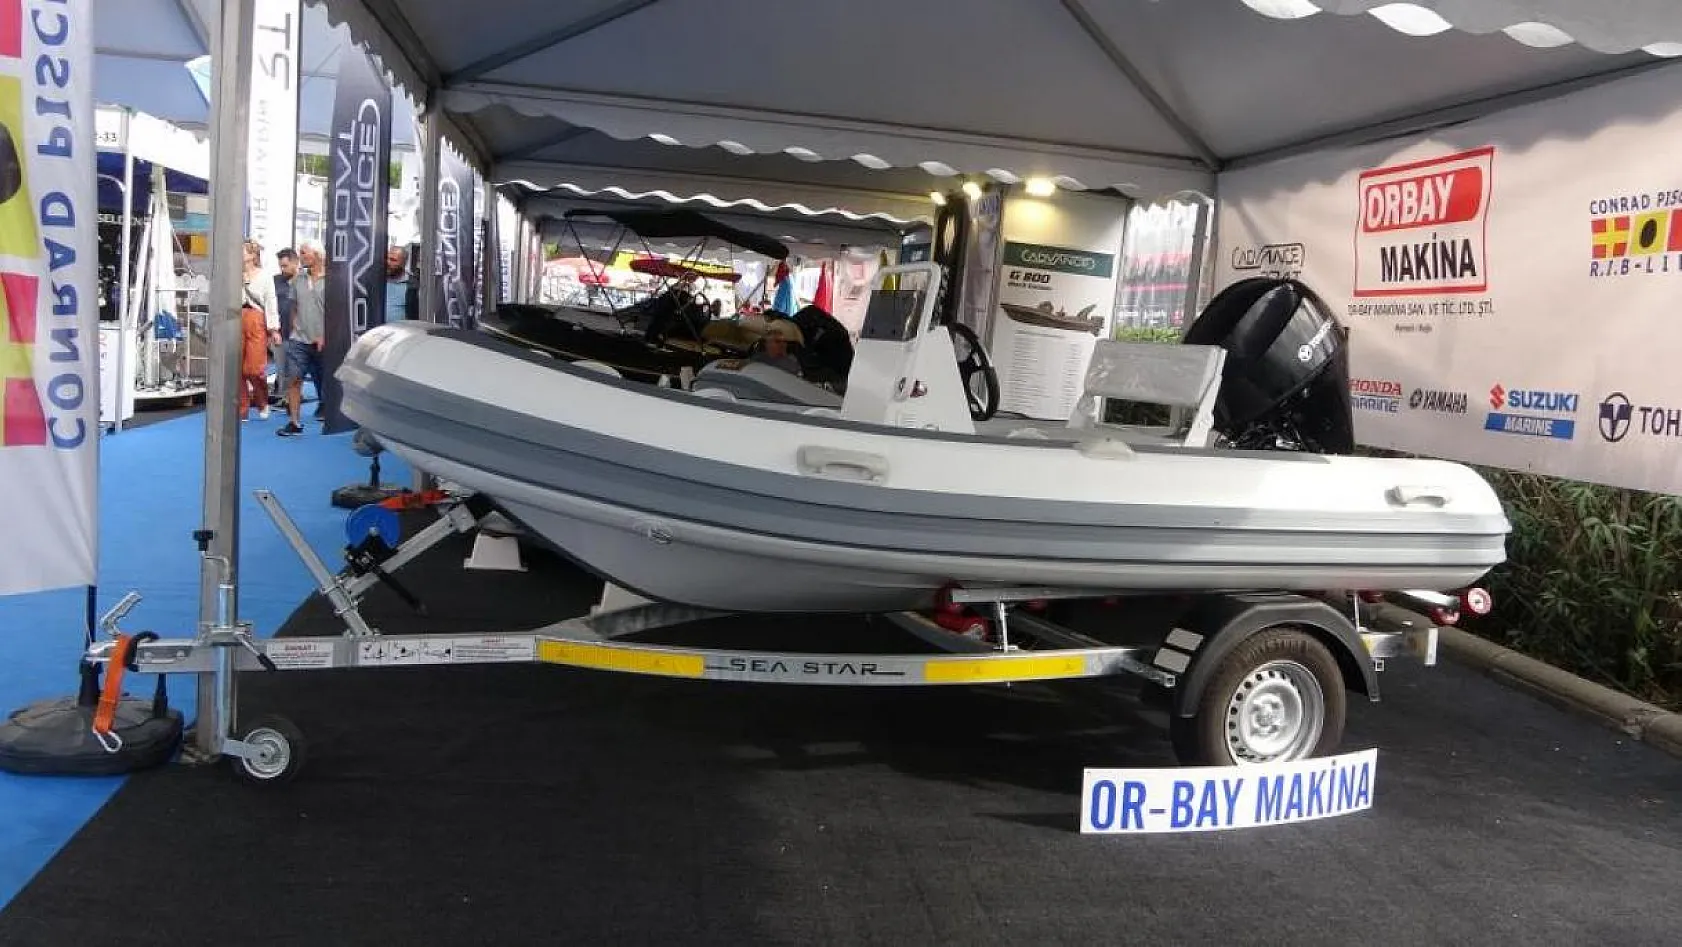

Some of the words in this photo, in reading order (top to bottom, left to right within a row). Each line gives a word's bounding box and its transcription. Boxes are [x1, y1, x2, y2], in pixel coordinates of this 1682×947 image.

[1366, 173, 1455, 229] ORBAY
[1590, 194, 1650, 215] CONRAD
[1380, 231, 1477, 282] MAKİNA
[1348, 379, 1401, 395] HONDA
[1423, 389, 1468, 413] YAMAHA
[1508, 391, 1579, 411] SUZUKI
[1504, 416, 1553, 436] MARINE
[1638, 405, 1682, 436] TOH
[730, 658, 778, 673] SEA
[803, 662, 882, 675] STAR
[1090, 778, 1243, 831] OR-BAY
[1254, 758, 1371, 824] MAKİNA
